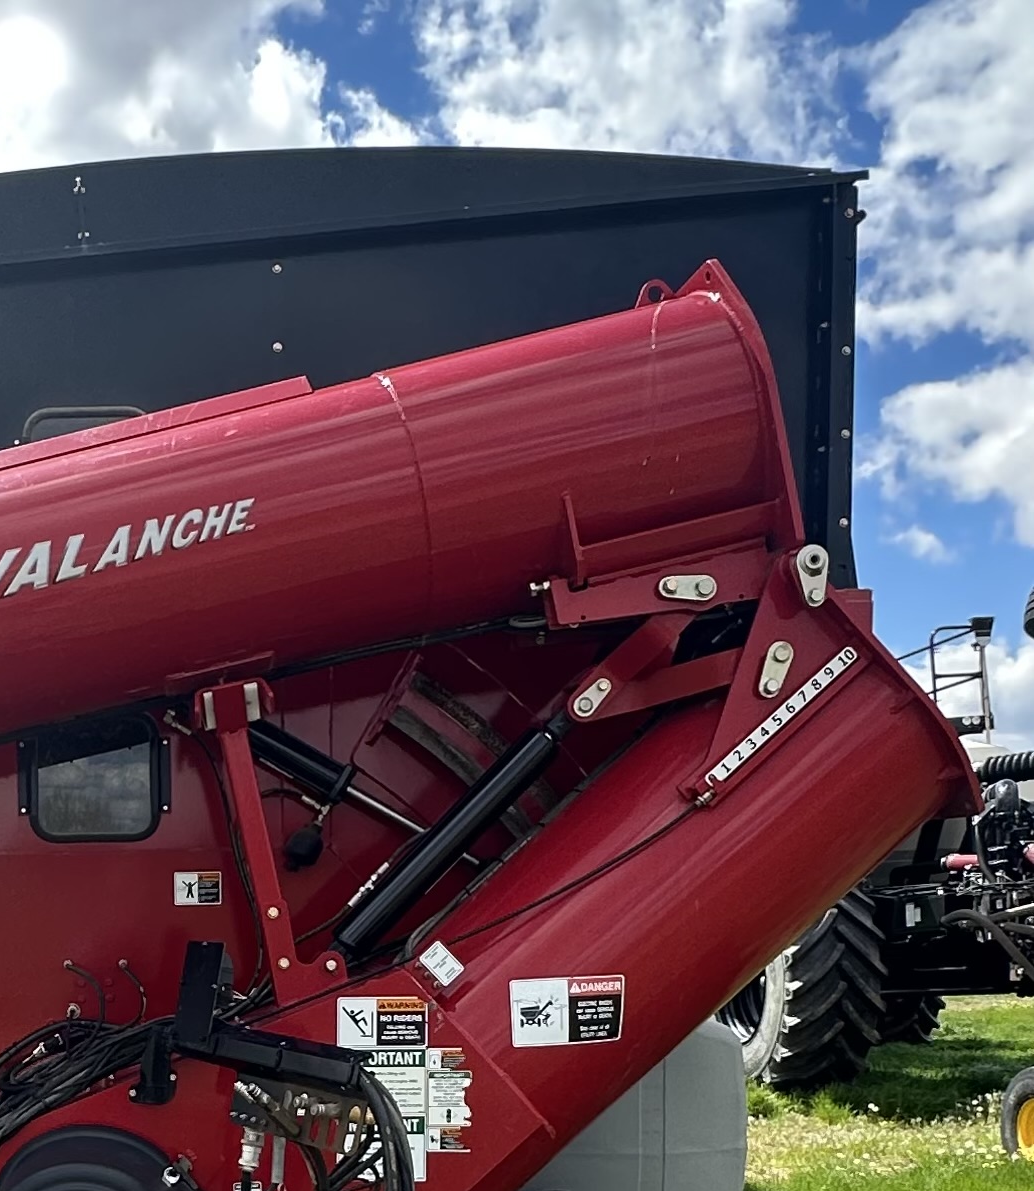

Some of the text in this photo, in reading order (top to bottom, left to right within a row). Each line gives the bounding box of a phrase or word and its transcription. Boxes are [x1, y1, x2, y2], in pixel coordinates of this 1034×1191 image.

[721, 649, 855, 774] 1 2 3 4 5 6 7 8 9 10
[580, 981, 621, 992] DANGER
[386, 1001, 424, 1009] WARNING
[380, 1014, 392, 1022] NO
[368, 1051, 423, 1066] ORTANT
